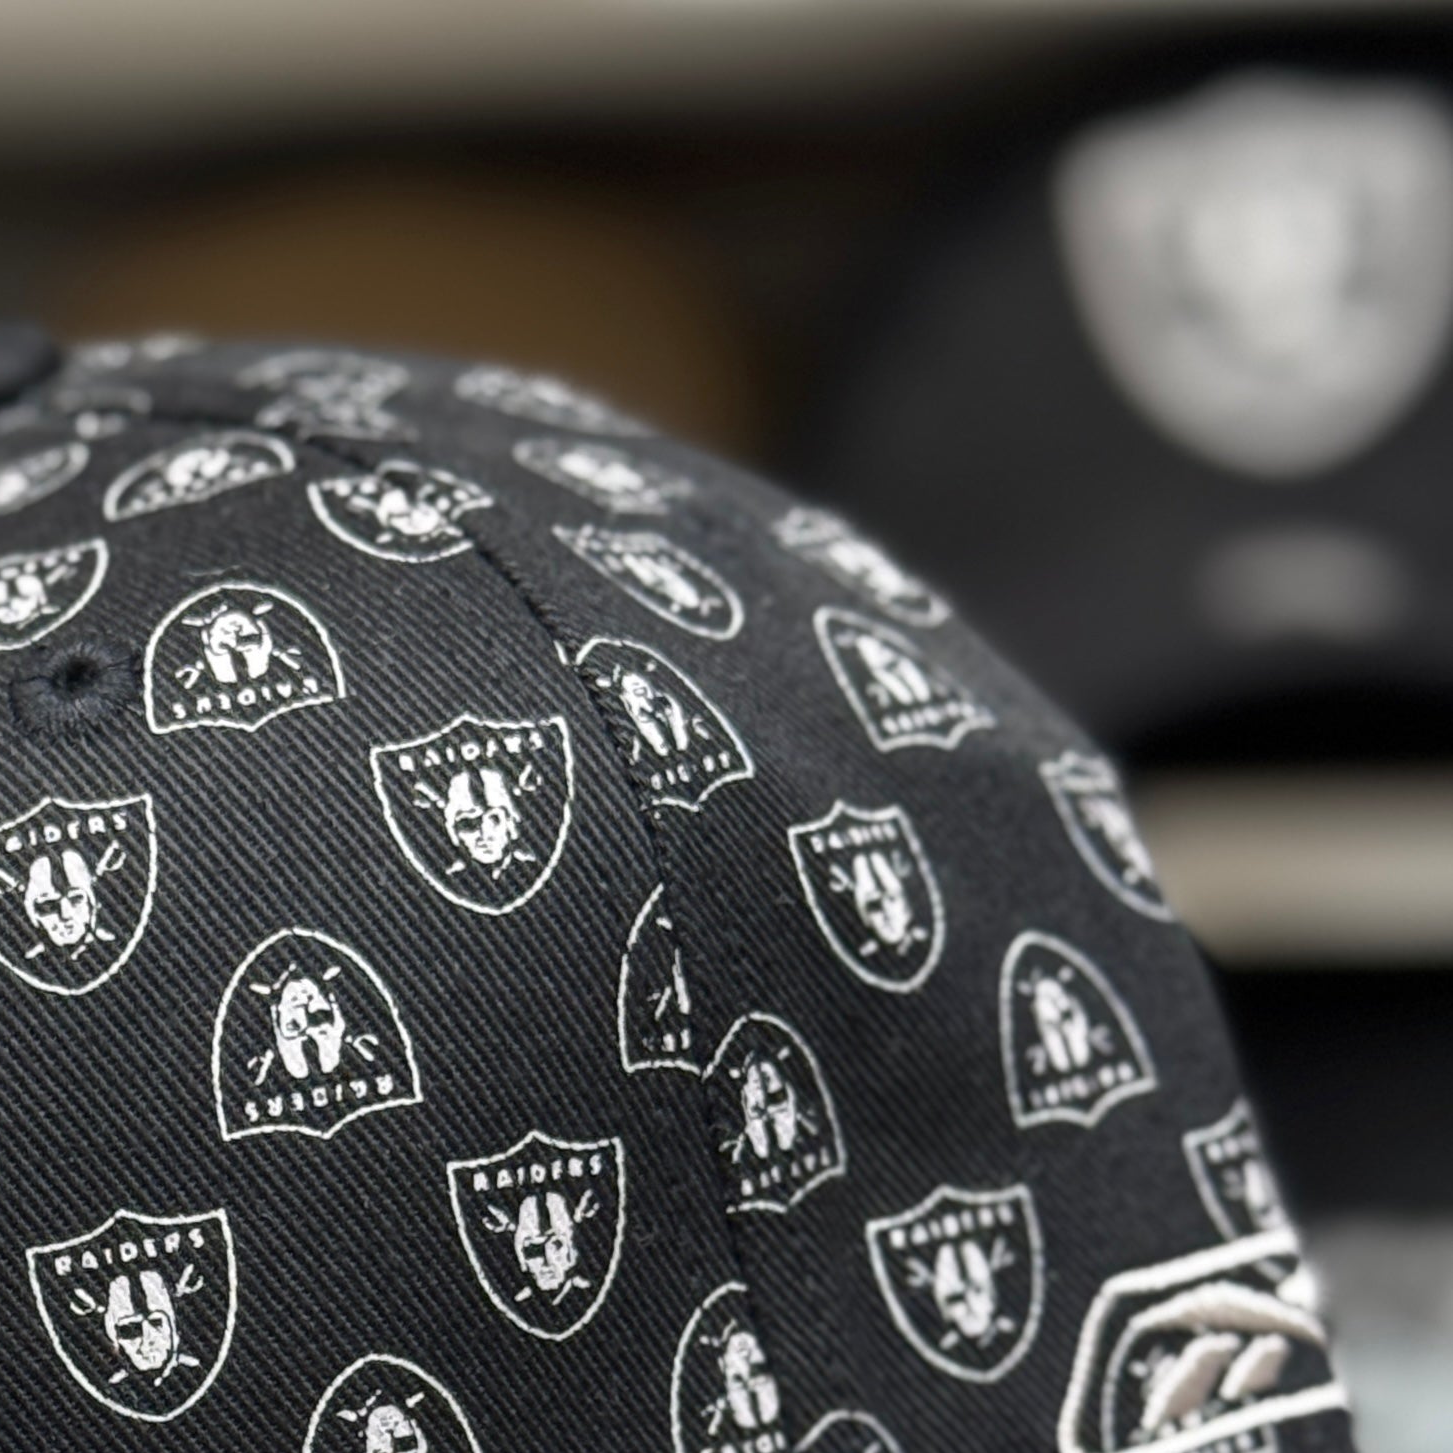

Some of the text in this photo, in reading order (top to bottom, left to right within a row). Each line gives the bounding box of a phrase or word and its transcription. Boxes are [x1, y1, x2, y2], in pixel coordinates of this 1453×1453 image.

[173, 679, 318, 717] RAIDERS
[245, 1073, 394, 1121] RAIDERS
[473, 1156, 602, 1190] RAIDERS
[55, 1229, 203, 1276] RAIDERS
